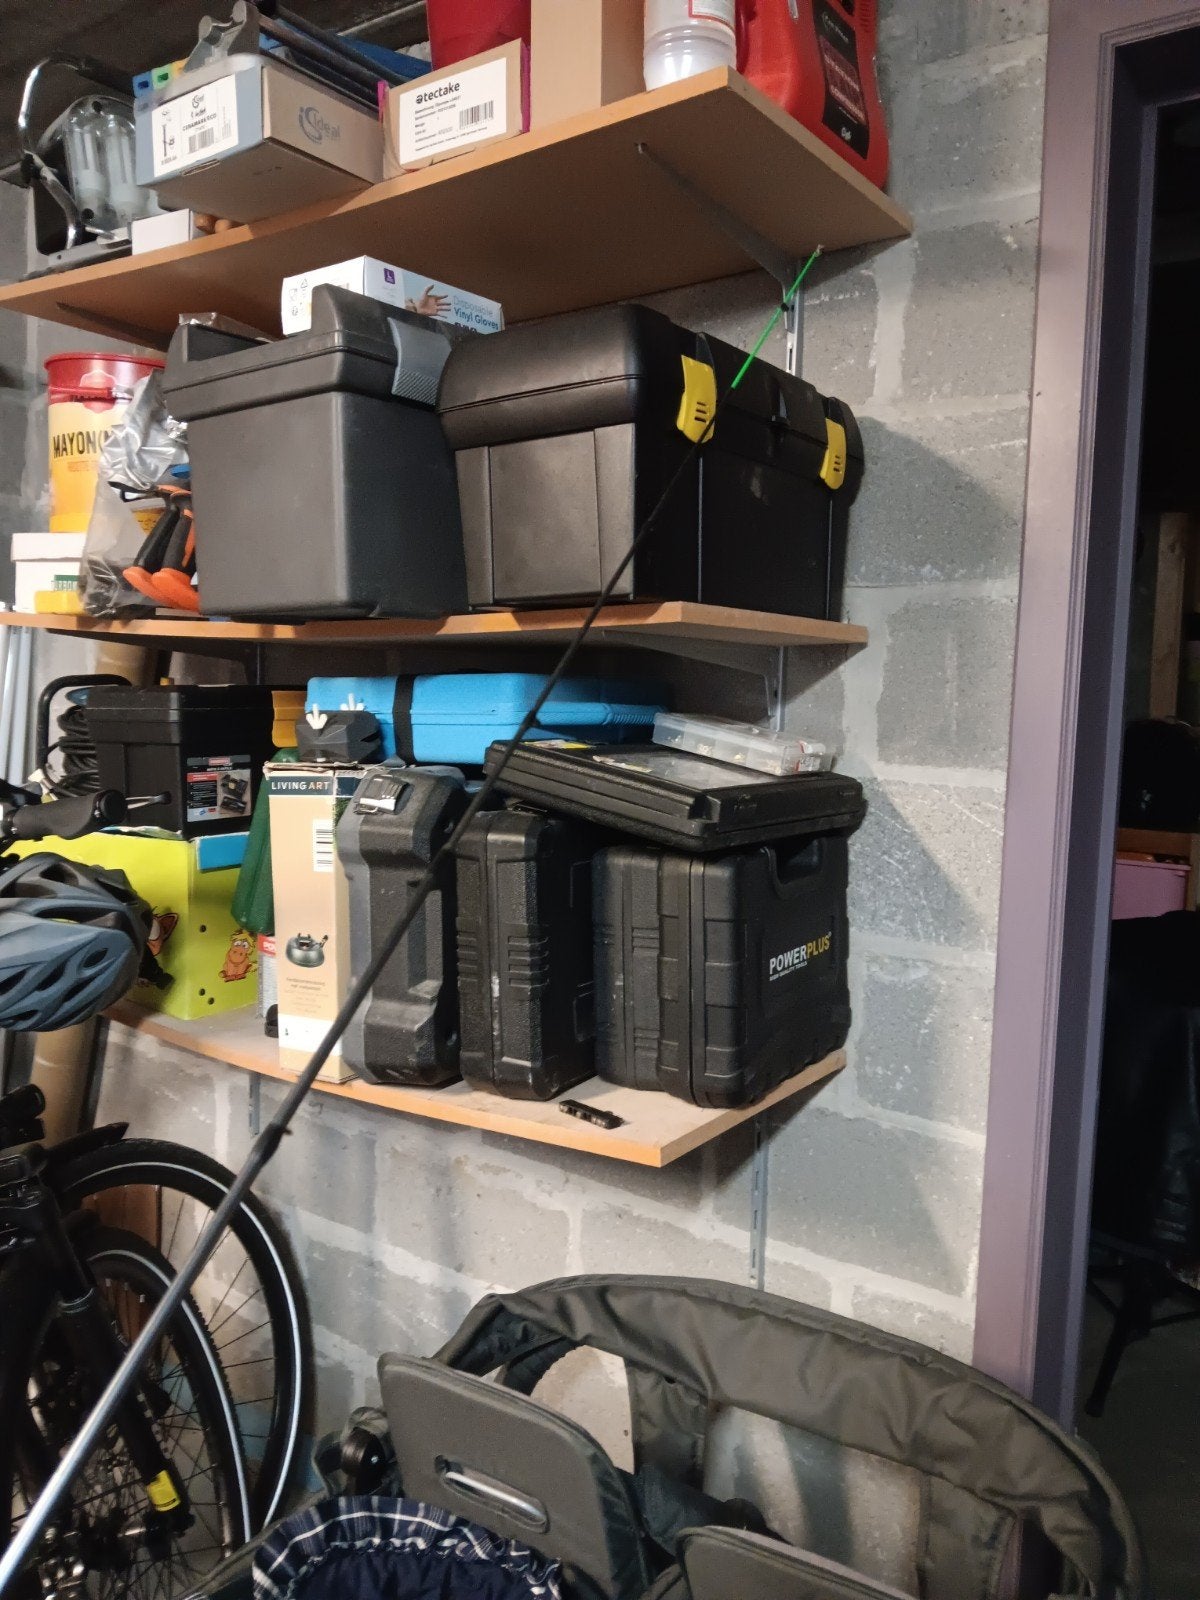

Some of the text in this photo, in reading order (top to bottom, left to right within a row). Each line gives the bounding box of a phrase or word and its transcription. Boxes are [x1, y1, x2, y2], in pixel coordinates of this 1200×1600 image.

[453, 295, 494, 317] Disposable
[453, 307, 474, 323] Vinyl
[474, 314, 499, 330] Gloves
